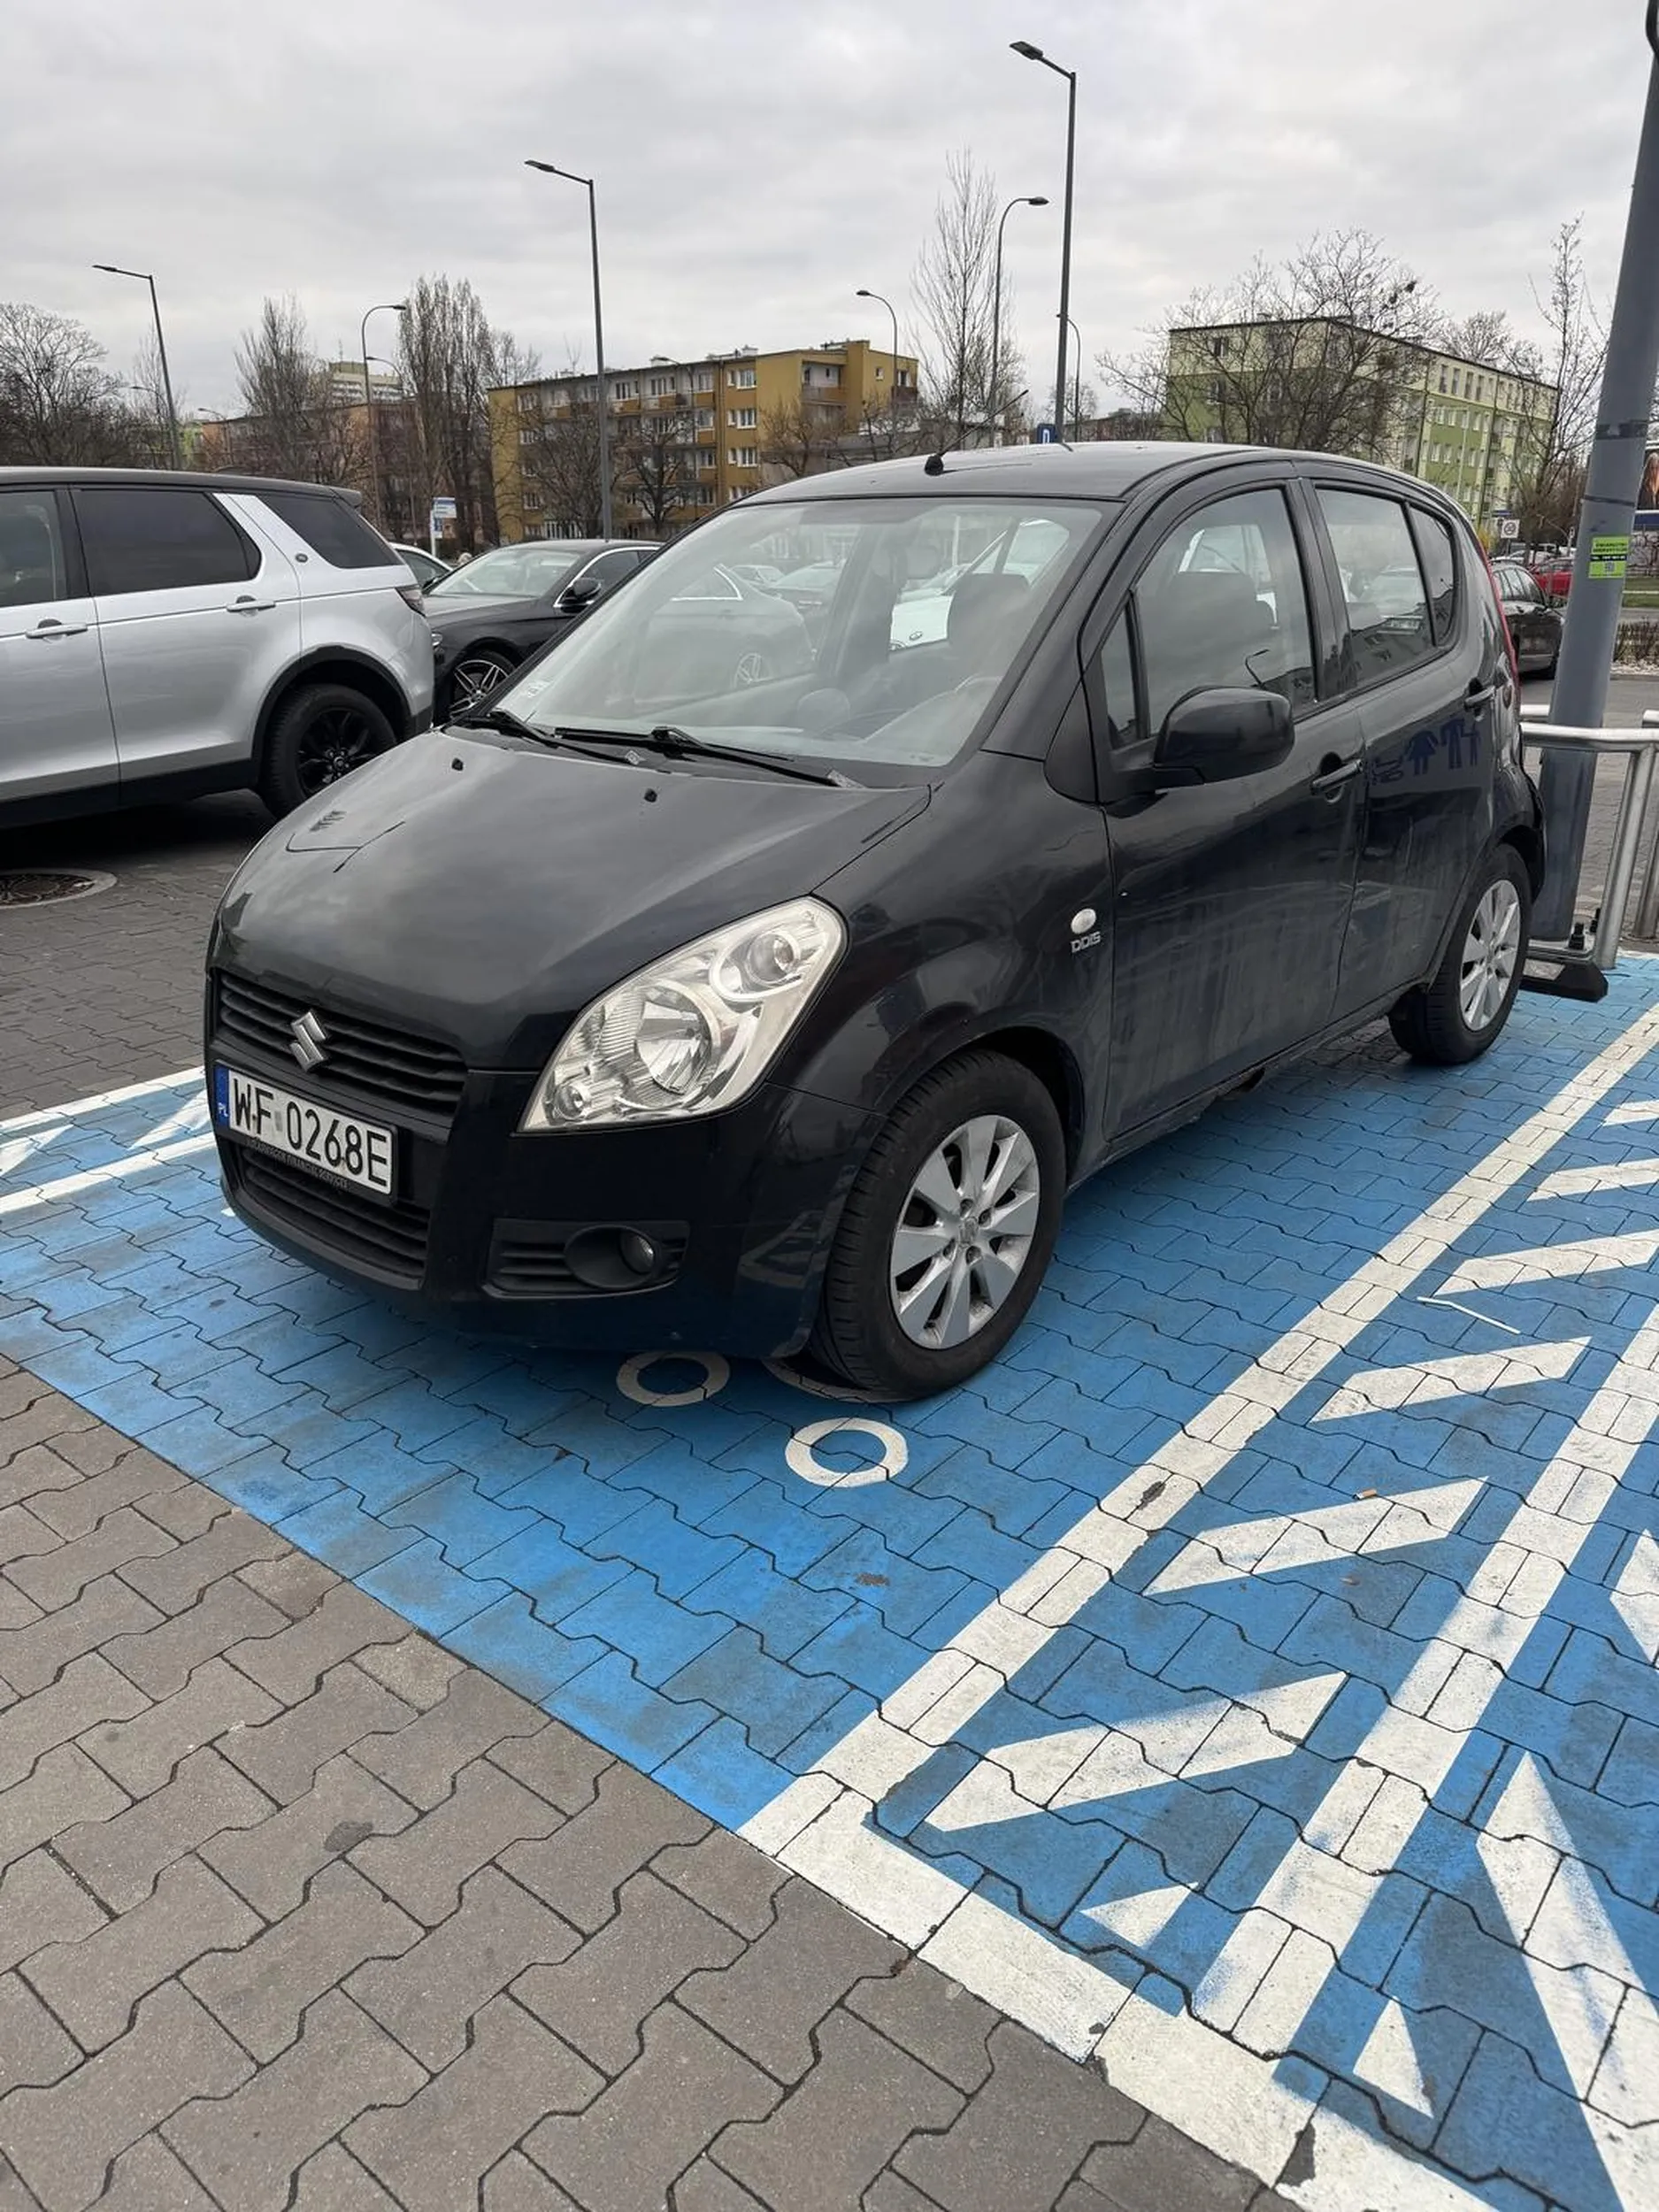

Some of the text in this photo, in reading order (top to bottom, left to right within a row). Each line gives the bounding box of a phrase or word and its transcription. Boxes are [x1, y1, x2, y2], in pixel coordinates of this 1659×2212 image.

[218, 1102, 228, 1117] PL
[234, 1079, 388, 1187] WF 0268E
